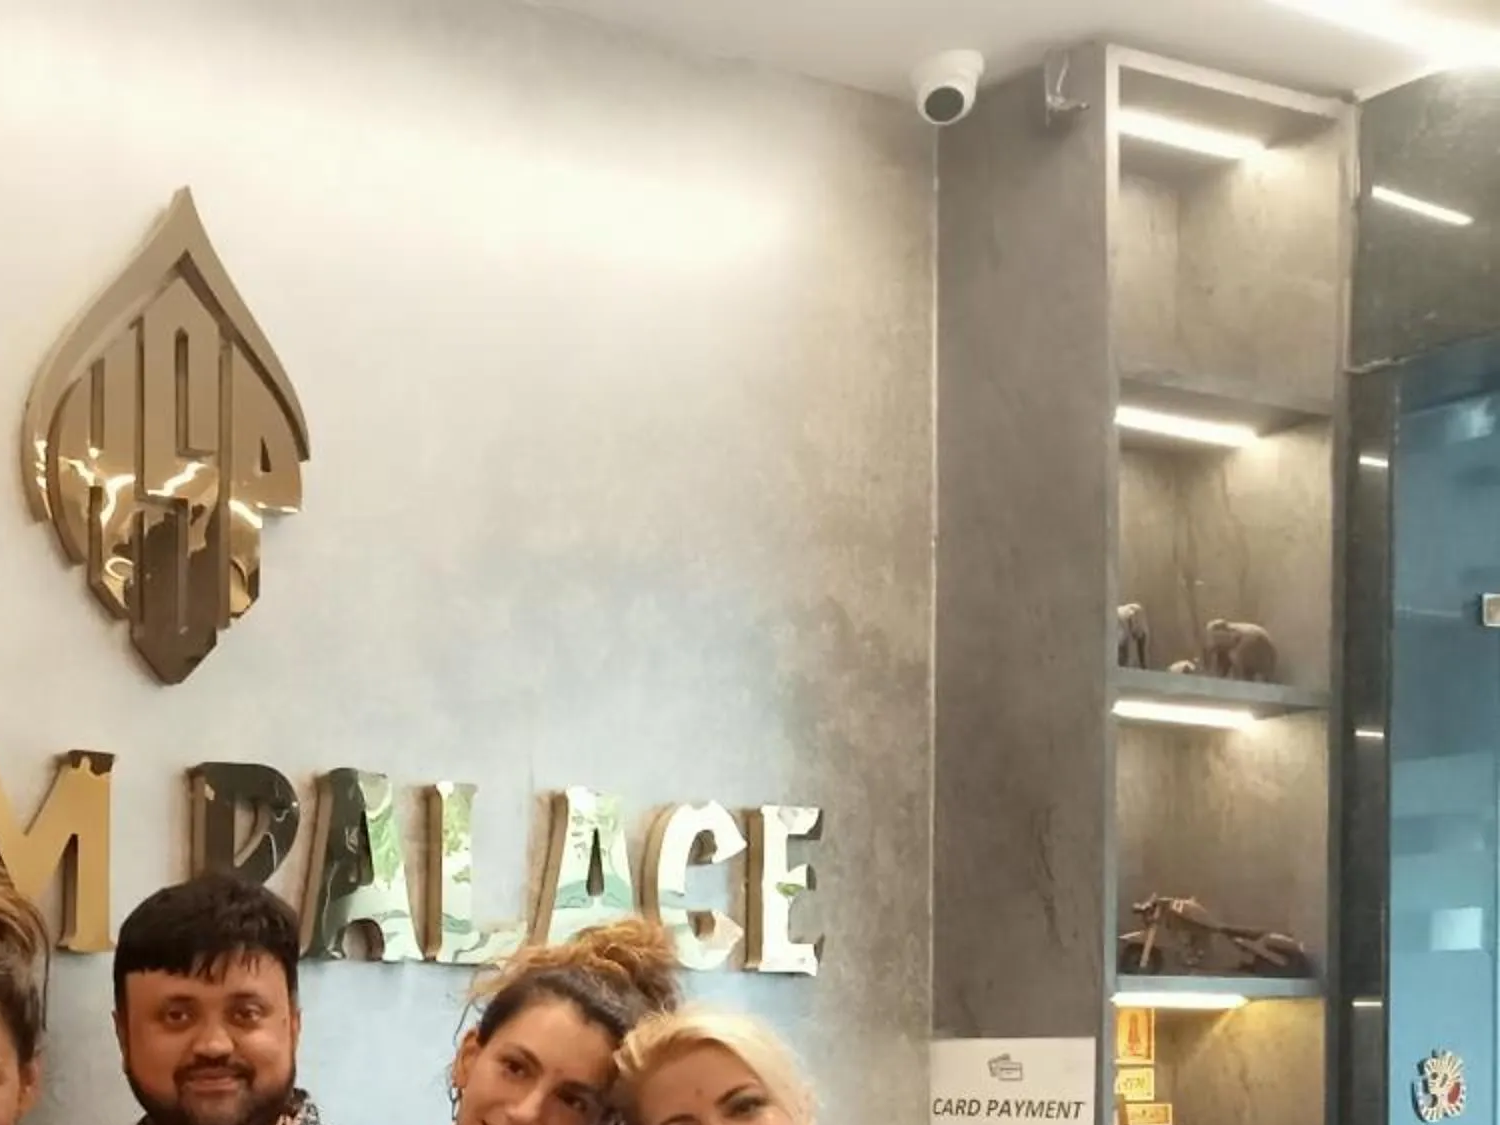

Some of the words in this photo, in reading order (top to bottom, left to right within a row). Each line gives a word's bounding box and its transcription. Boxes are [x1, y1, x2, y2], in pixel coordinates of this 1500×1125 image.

[185, 761, 823, 976] PALACE
[932, 1098, 981, 1117] CARD
[986, 1099, 1085, 1119] PAYMENT
